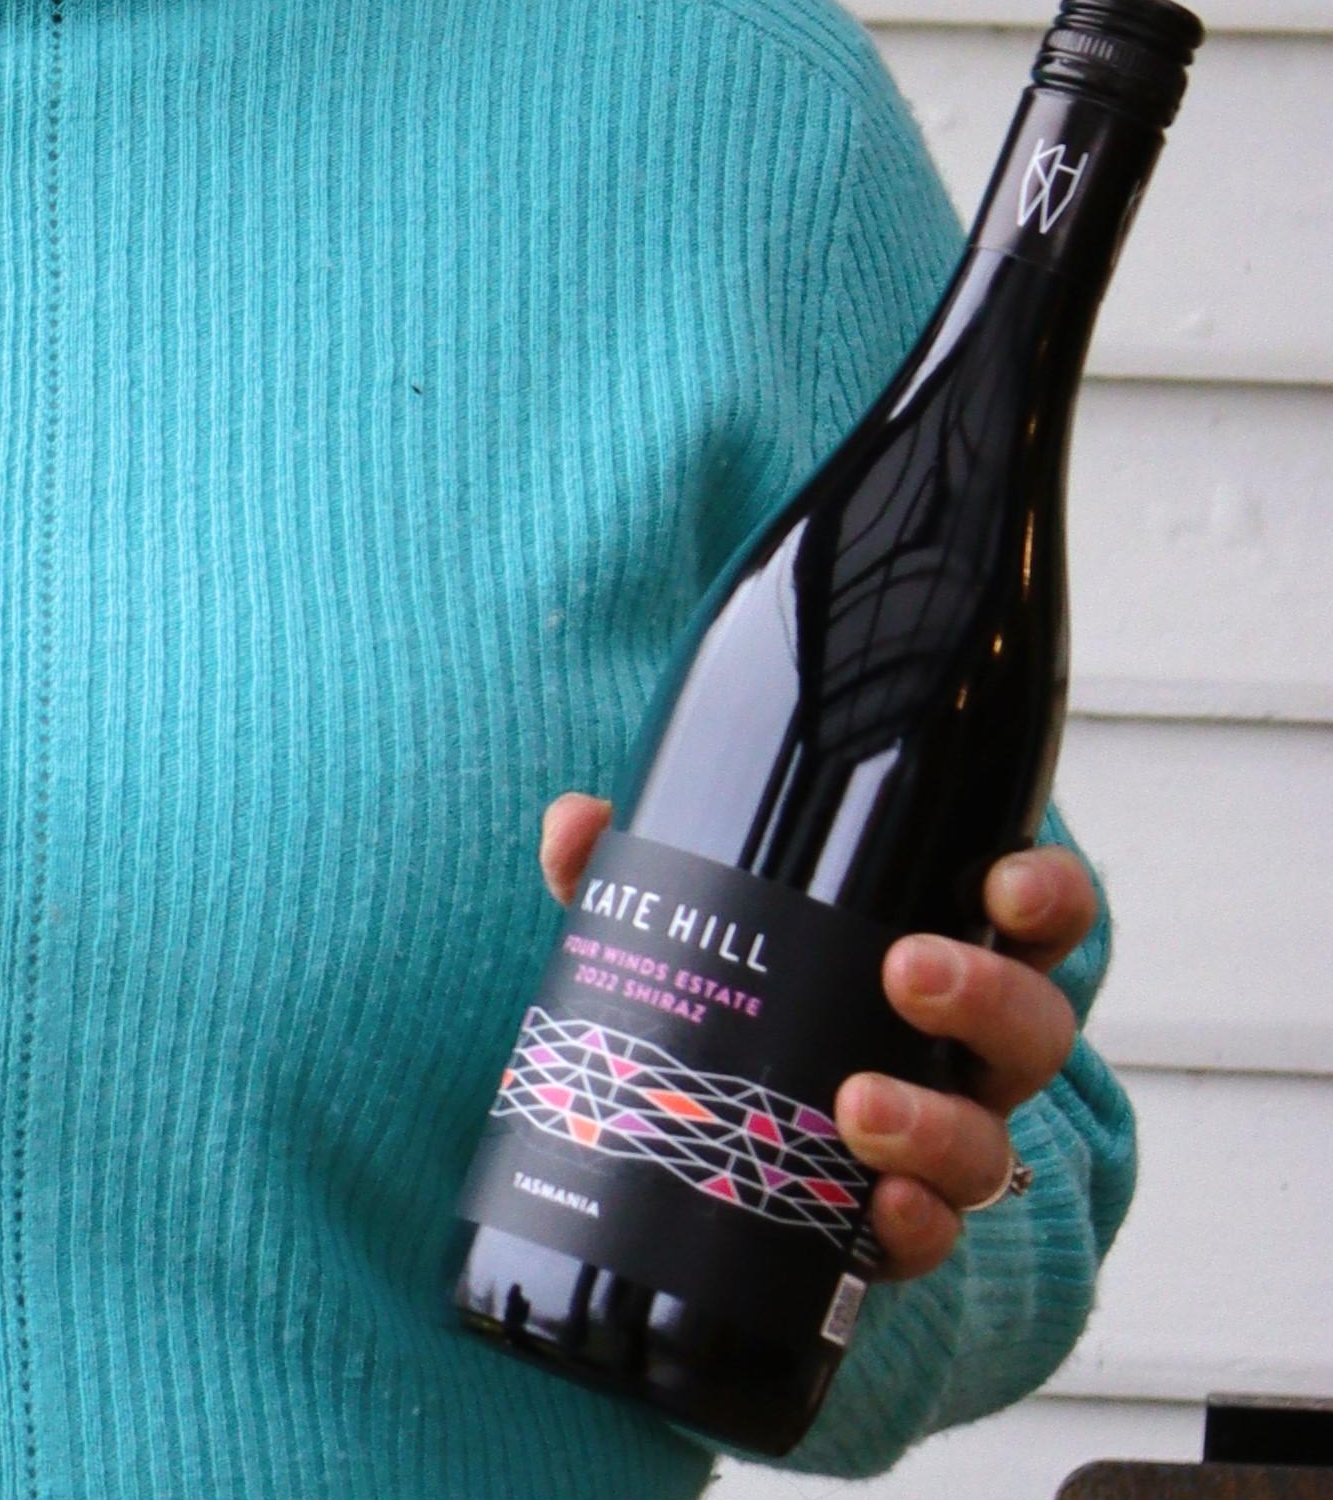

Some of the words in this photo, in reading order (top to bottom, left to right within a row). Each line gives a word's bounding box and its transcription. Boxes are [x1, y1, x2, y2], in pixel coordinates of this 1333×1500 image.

[580, 878, 661, 931] KATE
[668, 904, 767, 974] HILL
[575, 963, 619, 993] 2022
[623, 977, 707, 1024] SHIRAZ
[602, 944, 669, 983] WINDS
[674, 969, 763, 1018] ESTATE
[513, 1171, 601, 1218] TASMANIA
